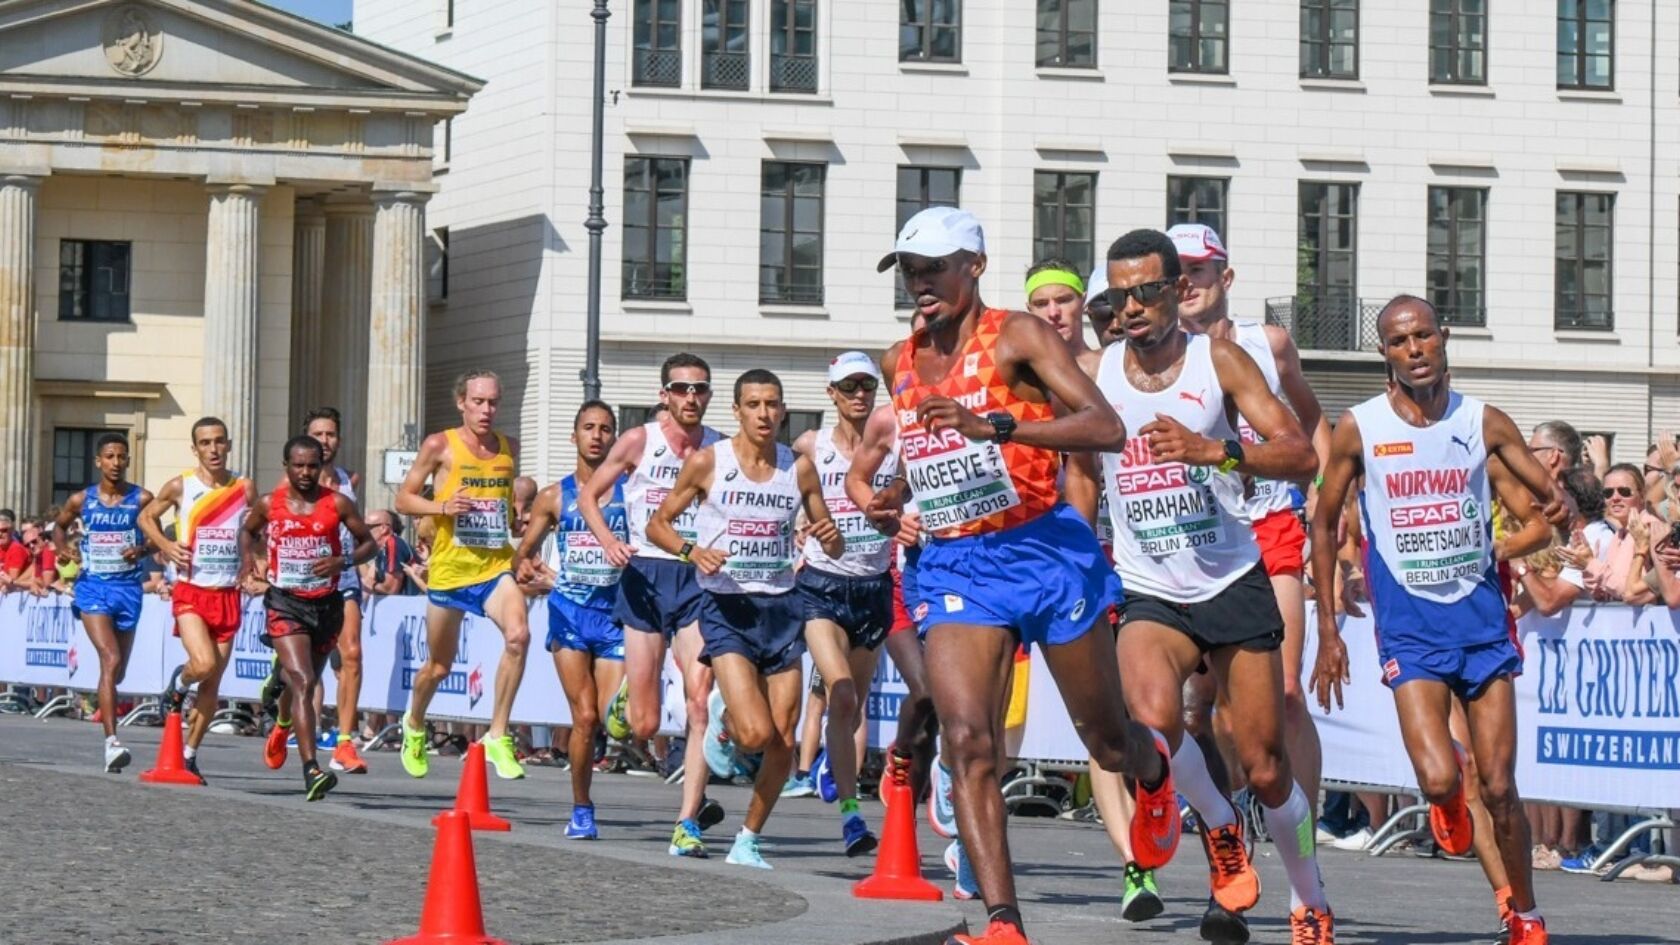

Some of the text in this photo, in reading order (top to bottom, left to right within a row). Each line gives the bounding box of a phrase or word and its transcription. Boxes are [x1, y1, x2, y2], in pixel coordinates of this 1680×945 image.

[904, 427, 965, 459] SPAR
[1120, 437, 1149, 468] SU
[909, 452, 987, 493] NAGEEYE
[1118, 467, 1185, 493] SPAR
[461, 476, 511, 488] SWEDEN
[1385, 467, 1470, 499] NORWAY
[735, 490, 794, 510] FRANCE
[952, 490, 985, 504] CLEAN
[471, 500, 498, 511] PAR
[825, 500, 858, 512] SPA
[924, 494, 1010, 528] BERLIN 2018
[1125, 491, 1204, 524] ABRAHAM
[90, 512, 131, 525] ITALIA
[456, 514, 502, 529] EKVALL
[1391, 505, 1459, 527] SPAR
[198, 529, 234, 540] SPAR
[728, 521, 778, 536] SPAR
[91, 534, 122, 544] SPAR
[569, 534, 601, 545] SPA
[1185, 530, 1217, 548] 2018
[1395, 526, 1472, 554] GEBRETSADIK
[198, 542, 240, 555] ESPAÑA
[280, 549, 317, 558] SPAR
[729, 539, 782, 557] CHAHDI
[1440, 555, 1465, 567] CLEAN
[730, 569, 764, 579] BERLIN
[1405, 562, 1480, 584] BERLIN 2018
[1537, 620, 1680, 719] LE GRUYÈR
